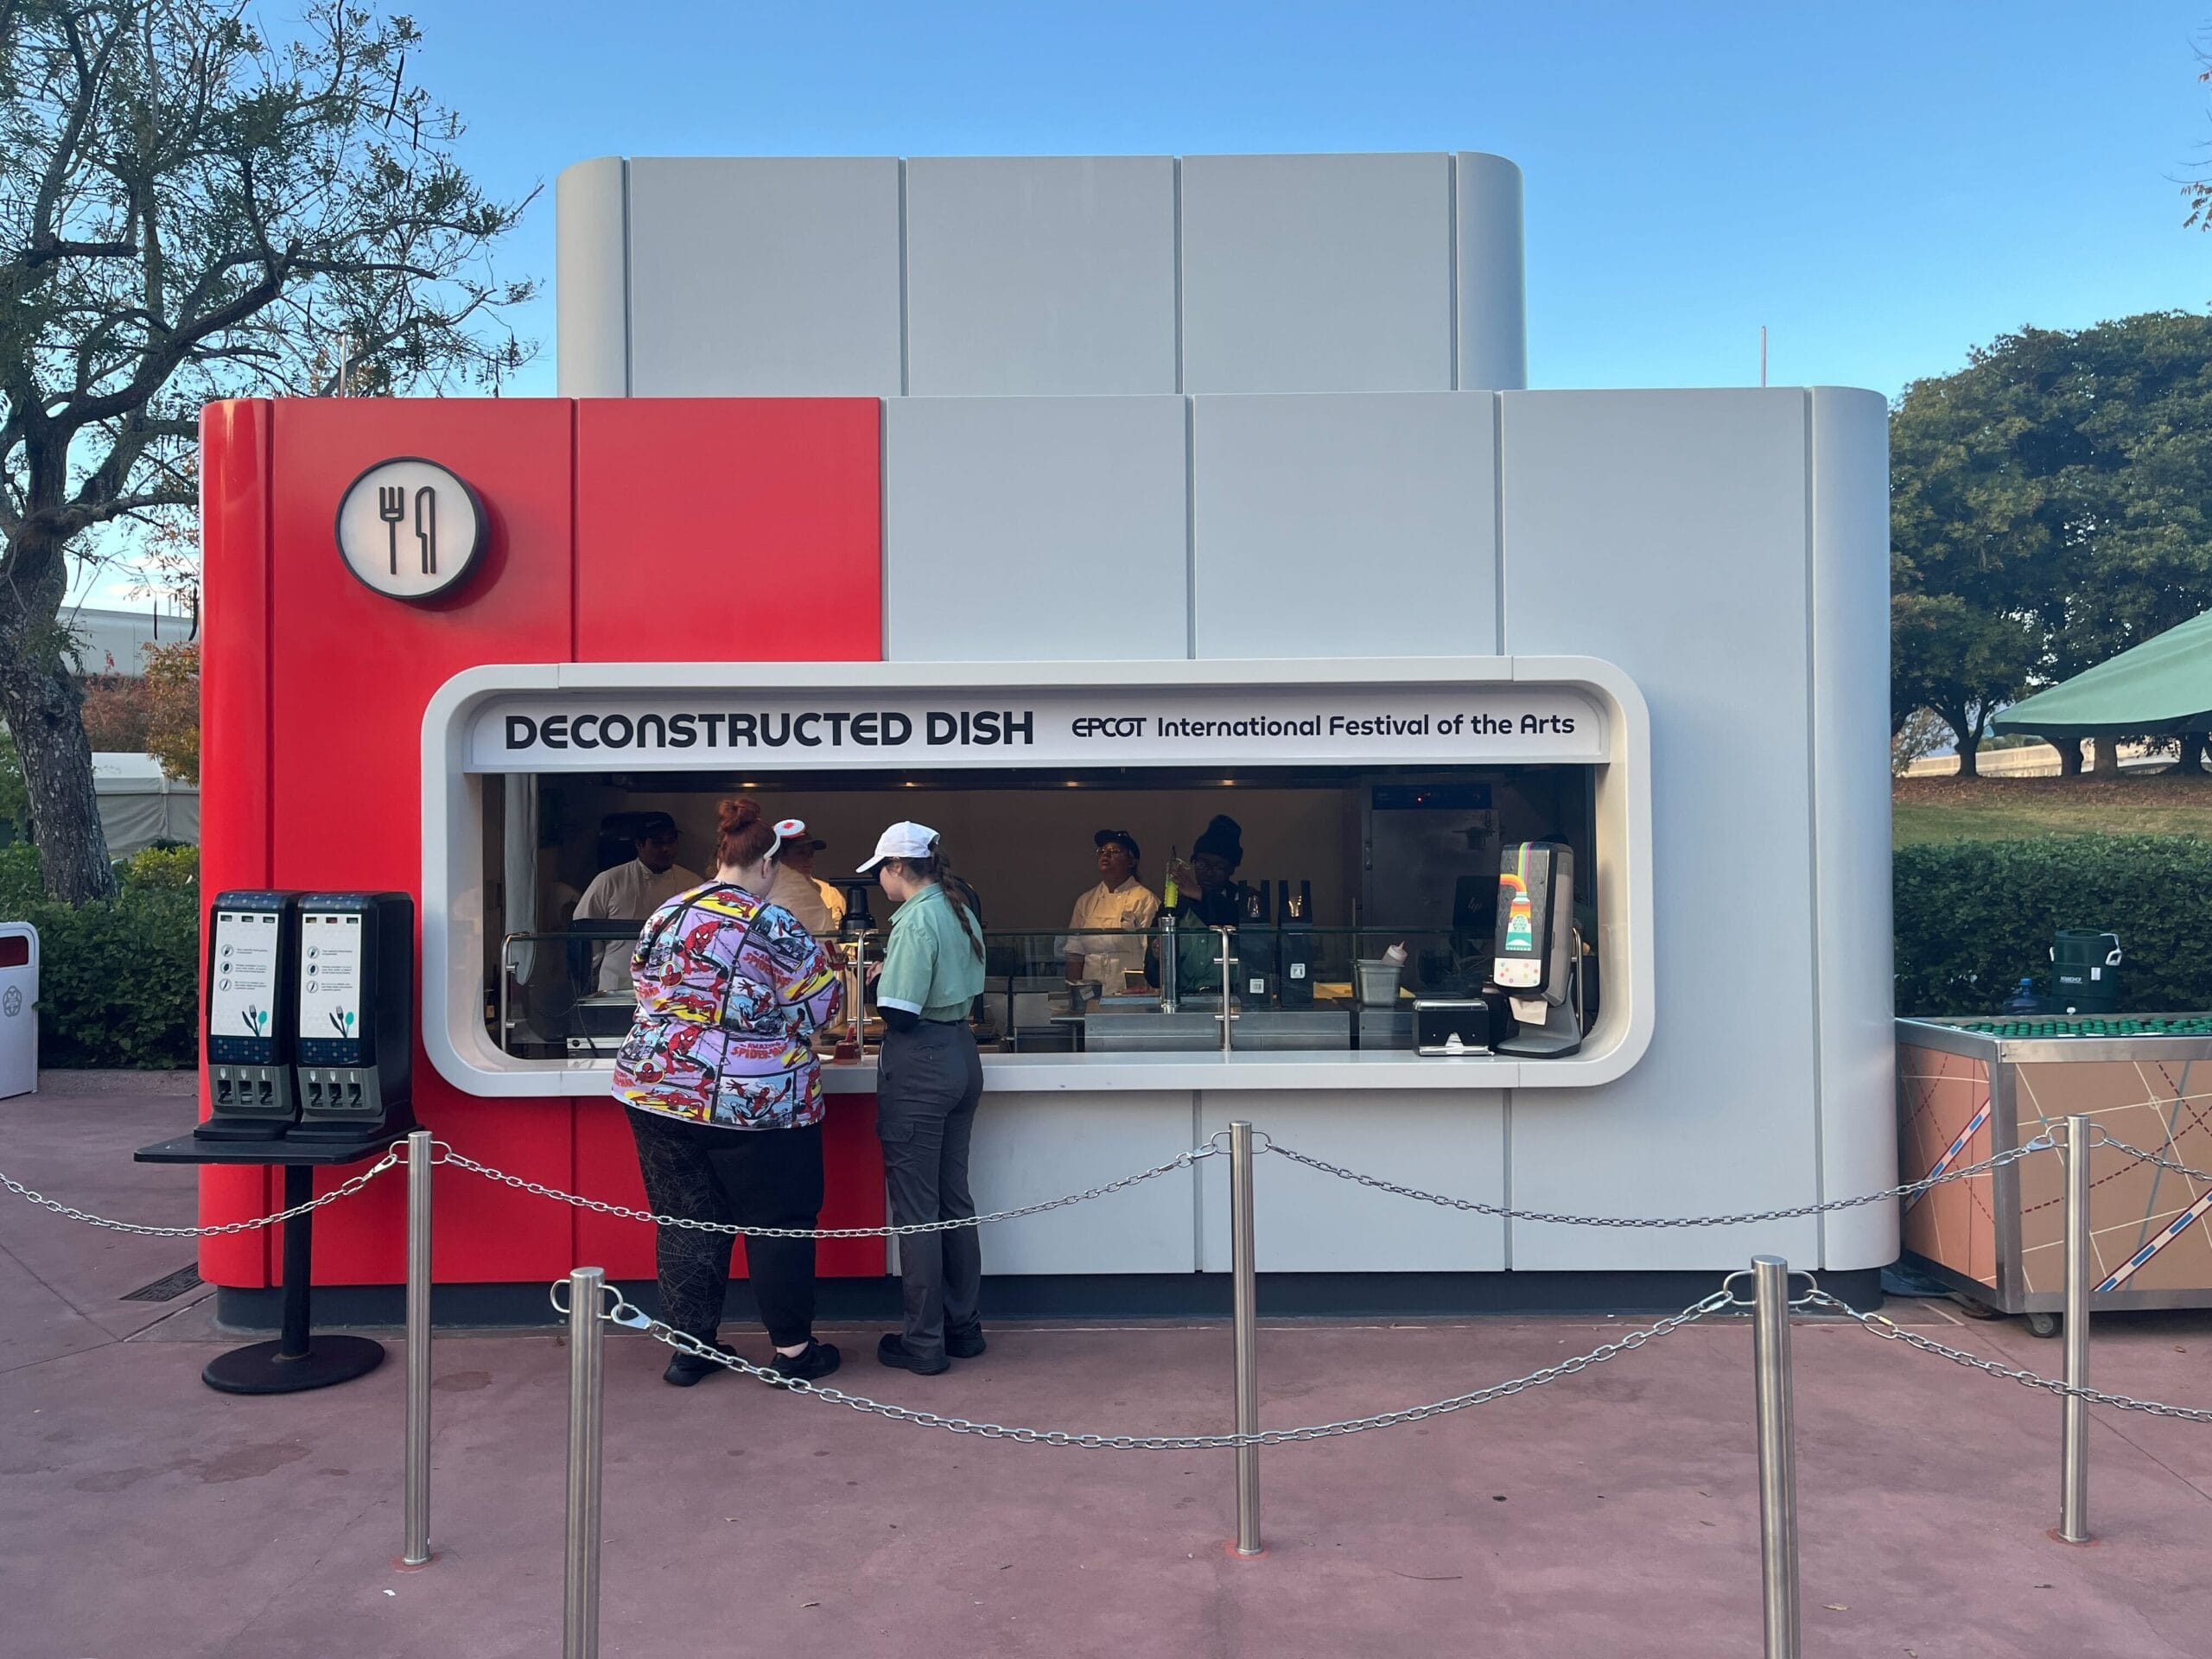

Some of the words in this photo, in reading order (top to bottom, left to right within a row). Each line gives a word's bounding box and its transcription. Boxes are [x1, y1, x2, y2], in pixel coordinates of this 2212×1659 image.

[505, 711, 912, 750] DECONSTRUCTED
[926, 710, 1034, 746] DISH
[1071, 717, 1147, 737] EPCOT
[1158, 715, 1321, 737] International
[1329, 715, 1429, 736] Festival
[1437, 715, 1464, 735] of
[1470, 714, 1513, 734] the
[1520, 714, 1575, 734] Arts
